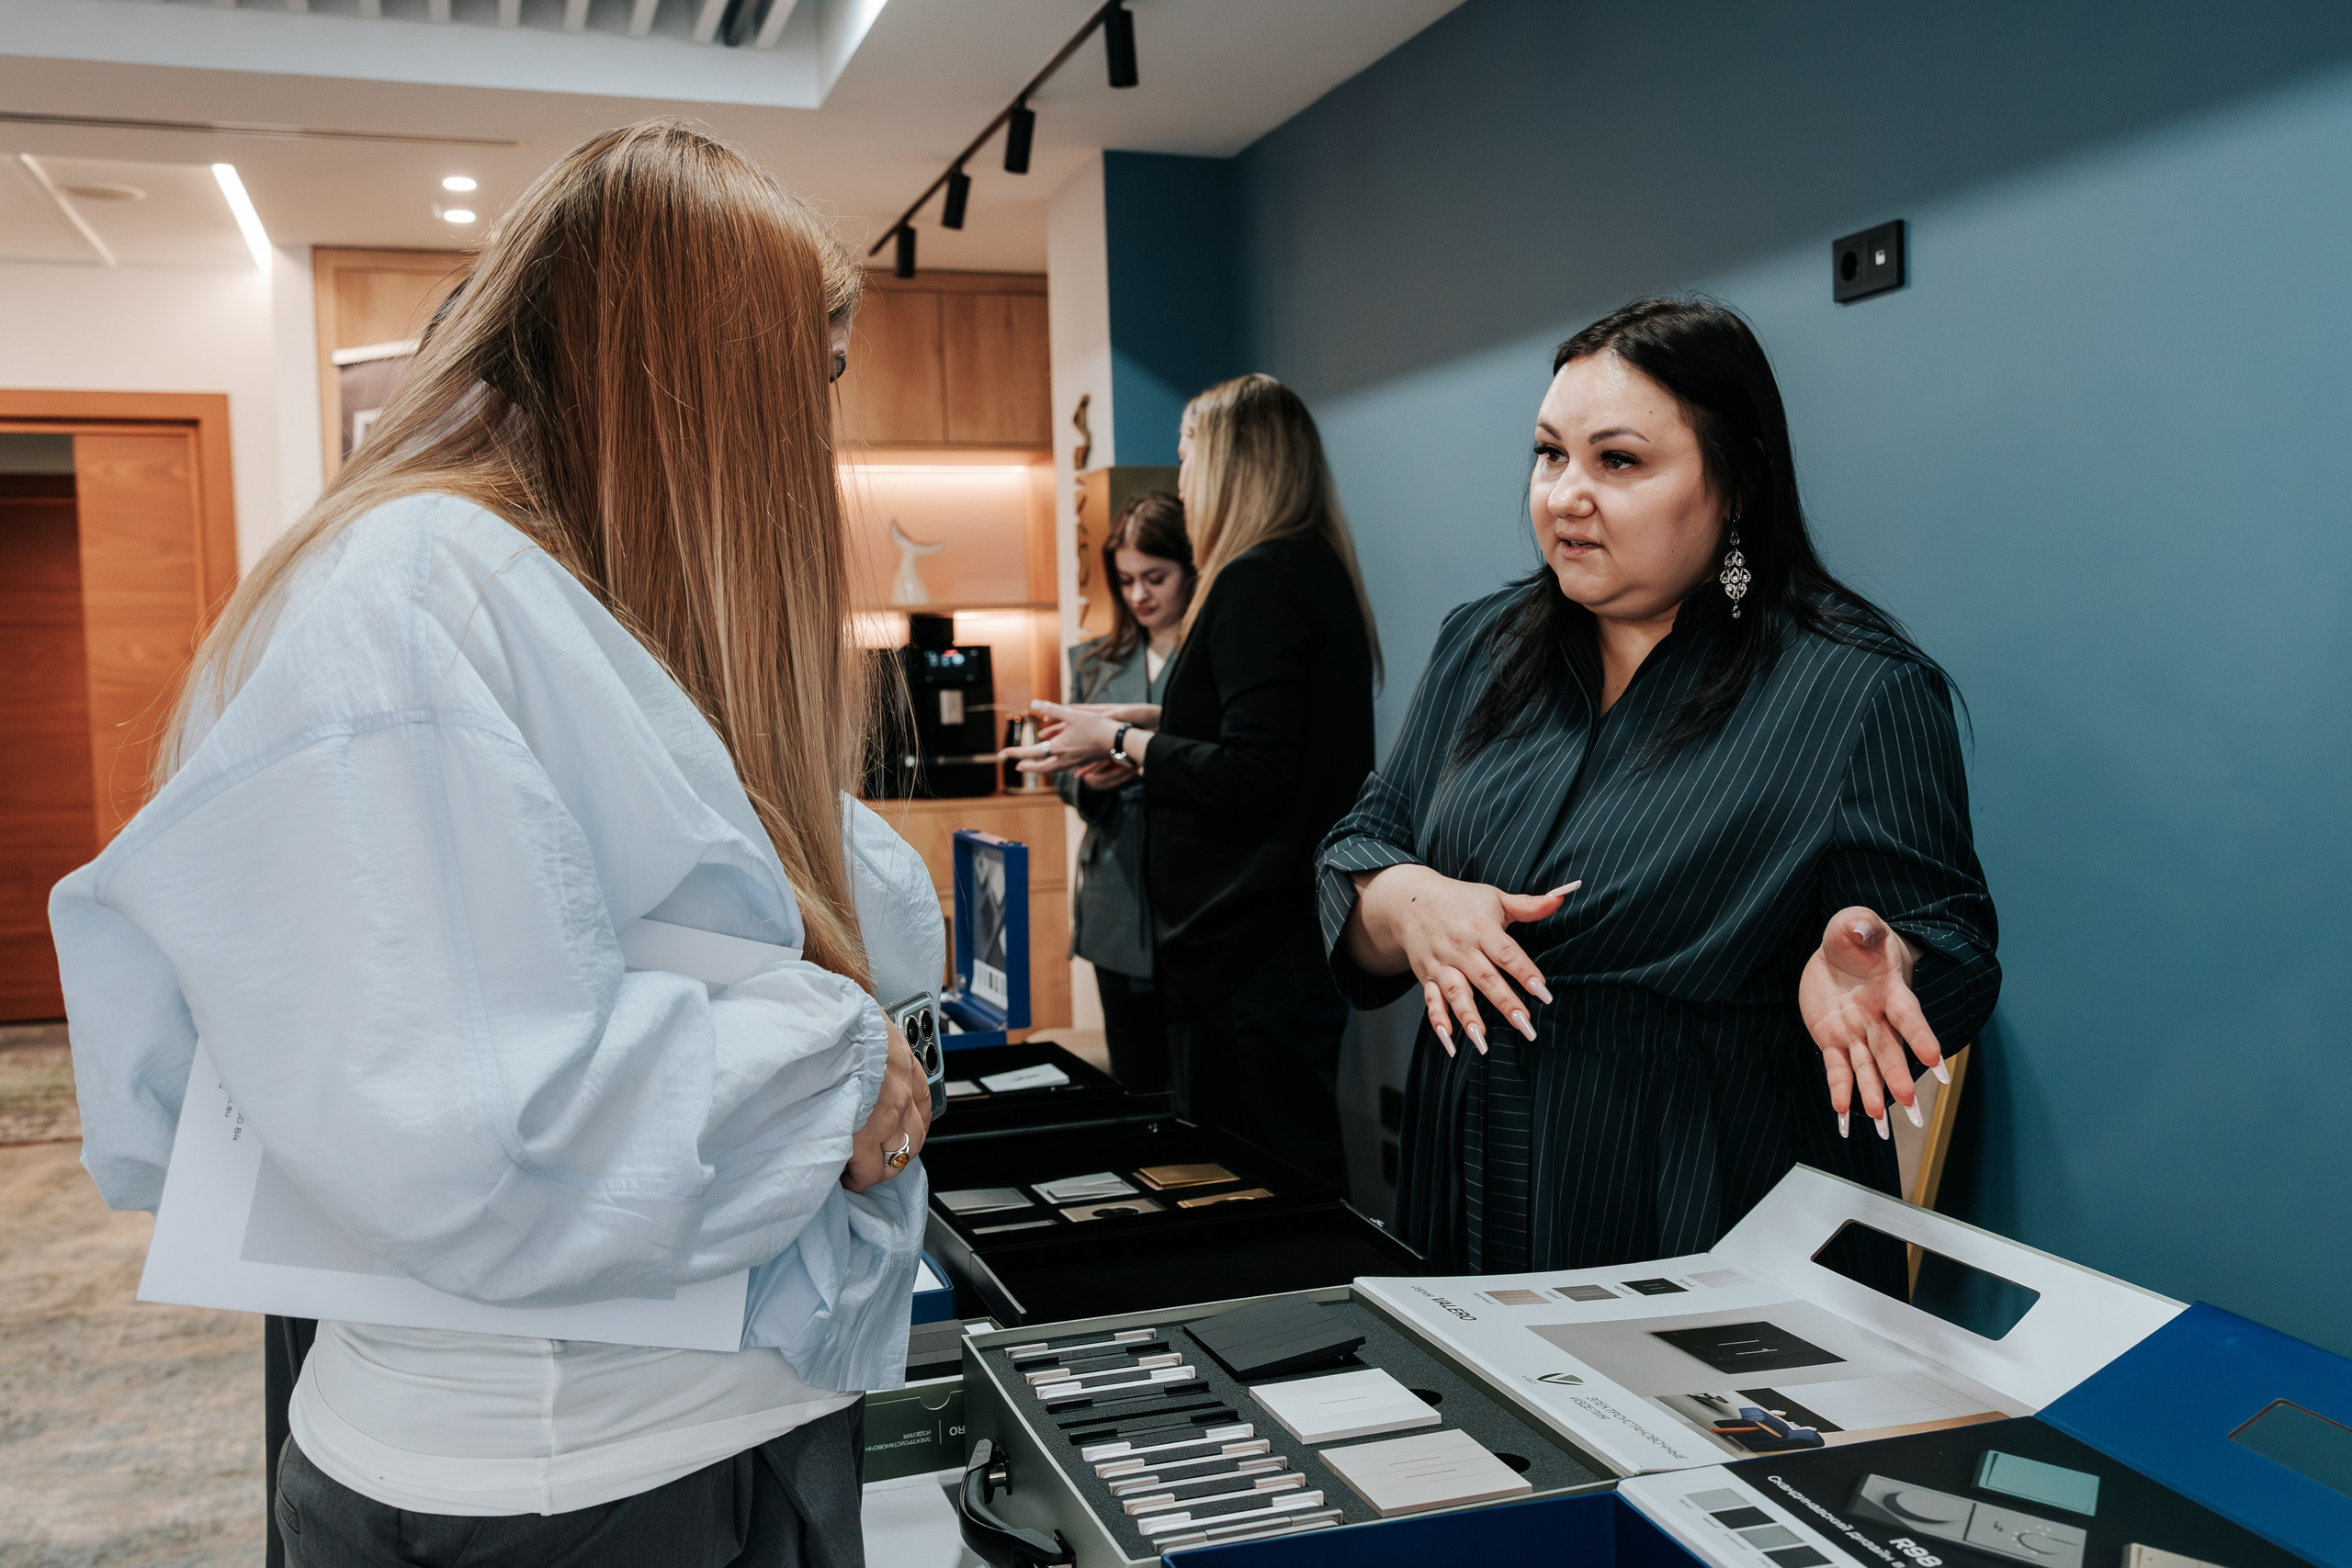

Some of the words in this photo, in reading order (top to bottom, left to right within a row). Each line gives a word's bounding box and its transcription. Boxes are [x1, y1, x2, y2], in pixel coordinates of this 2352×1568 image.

[1430, 1297, 1477, 1321] VALERO
[1568, 1395, 1611, 1421] ИЗДЕЛИЯ
[1585, 1395, 1690, 1461] ЭЛЕКТРОУСТАНОВОЧНЫЕ
[1767, 1474, 1855, 1532] Скандинавский
[1845, 1531, 1896, 1562] дизайн
[1888, 1537, 1944, 1568] R98
